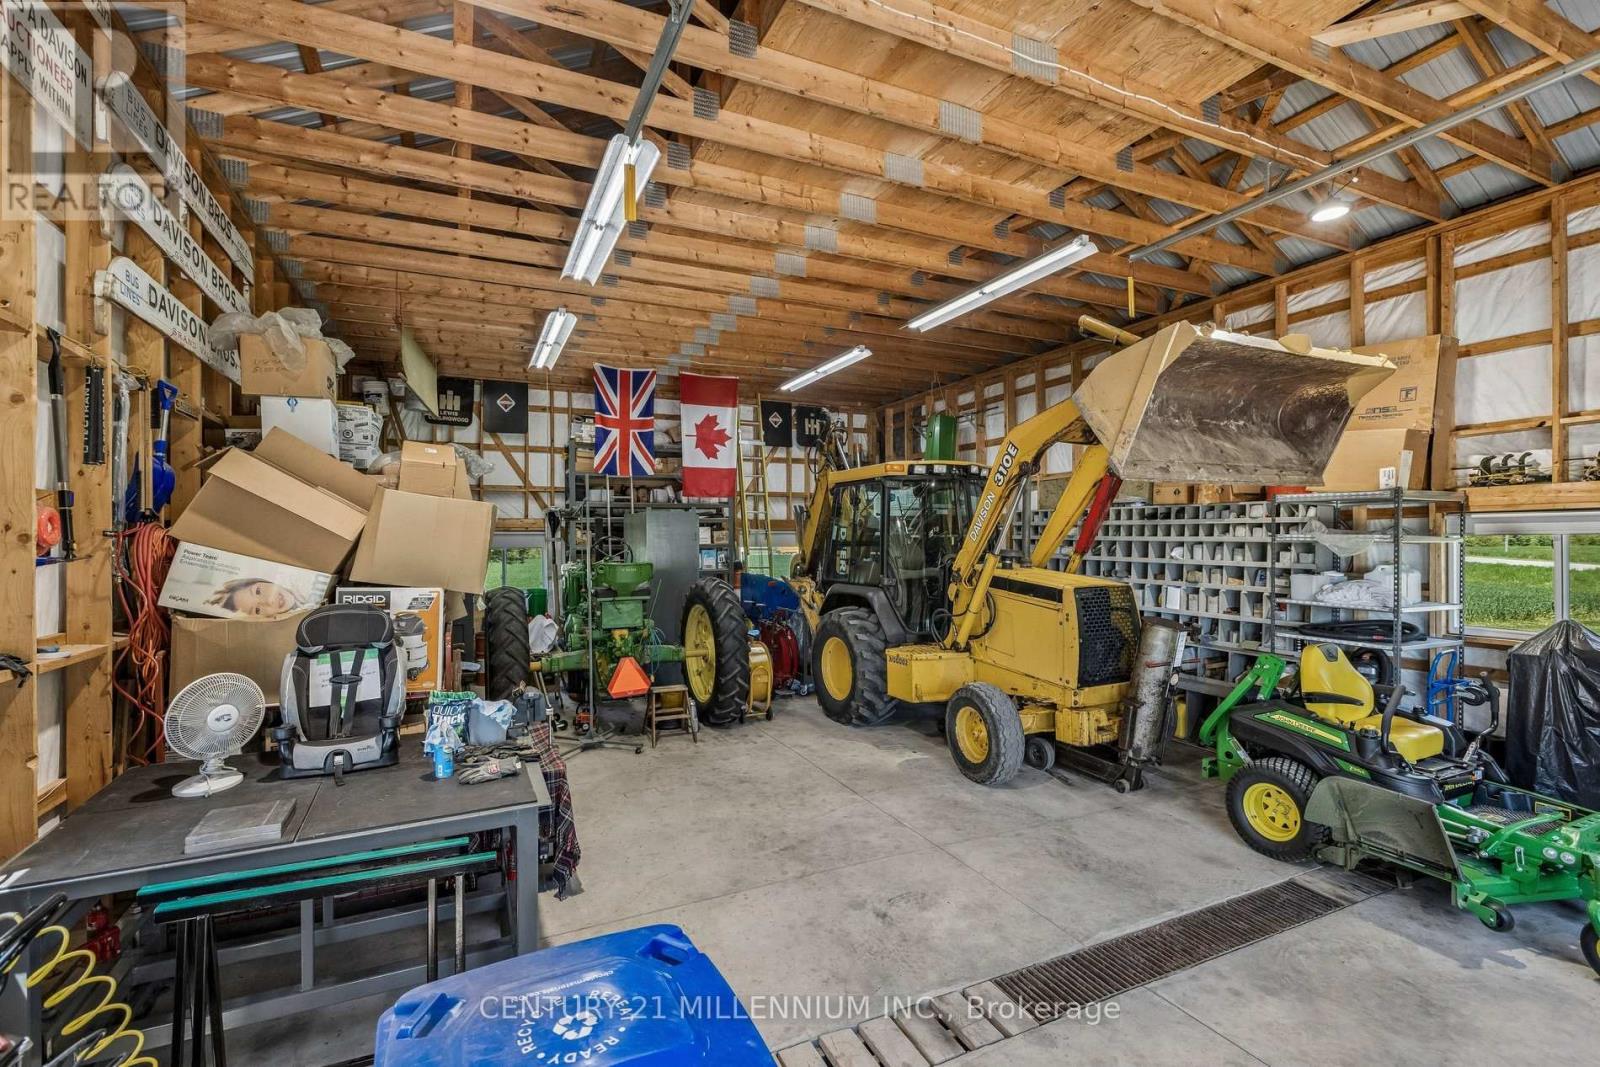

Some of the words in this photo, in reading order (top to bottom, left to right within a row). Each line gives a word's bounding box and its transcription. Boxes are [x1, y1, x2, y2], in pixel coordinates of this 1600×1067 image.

[1, 34, 36, 80] APPLY
[39, 72, 71, 118] WITHIN
[40, 15, 87, 88] DAVISON
[155, 121, 206, 205] DAVISON
[153, 200, 208, 278] DAVISON
[120, 285, 141, 306] LINES
[125, 270, 140, 290] BUS
[148, 282, 207, 346] DAVISON
[994, 440, 1019, 488] 310E
[969, 491, 996, 542] DAVISON
[342, 595, 386, 604] RIDGID
